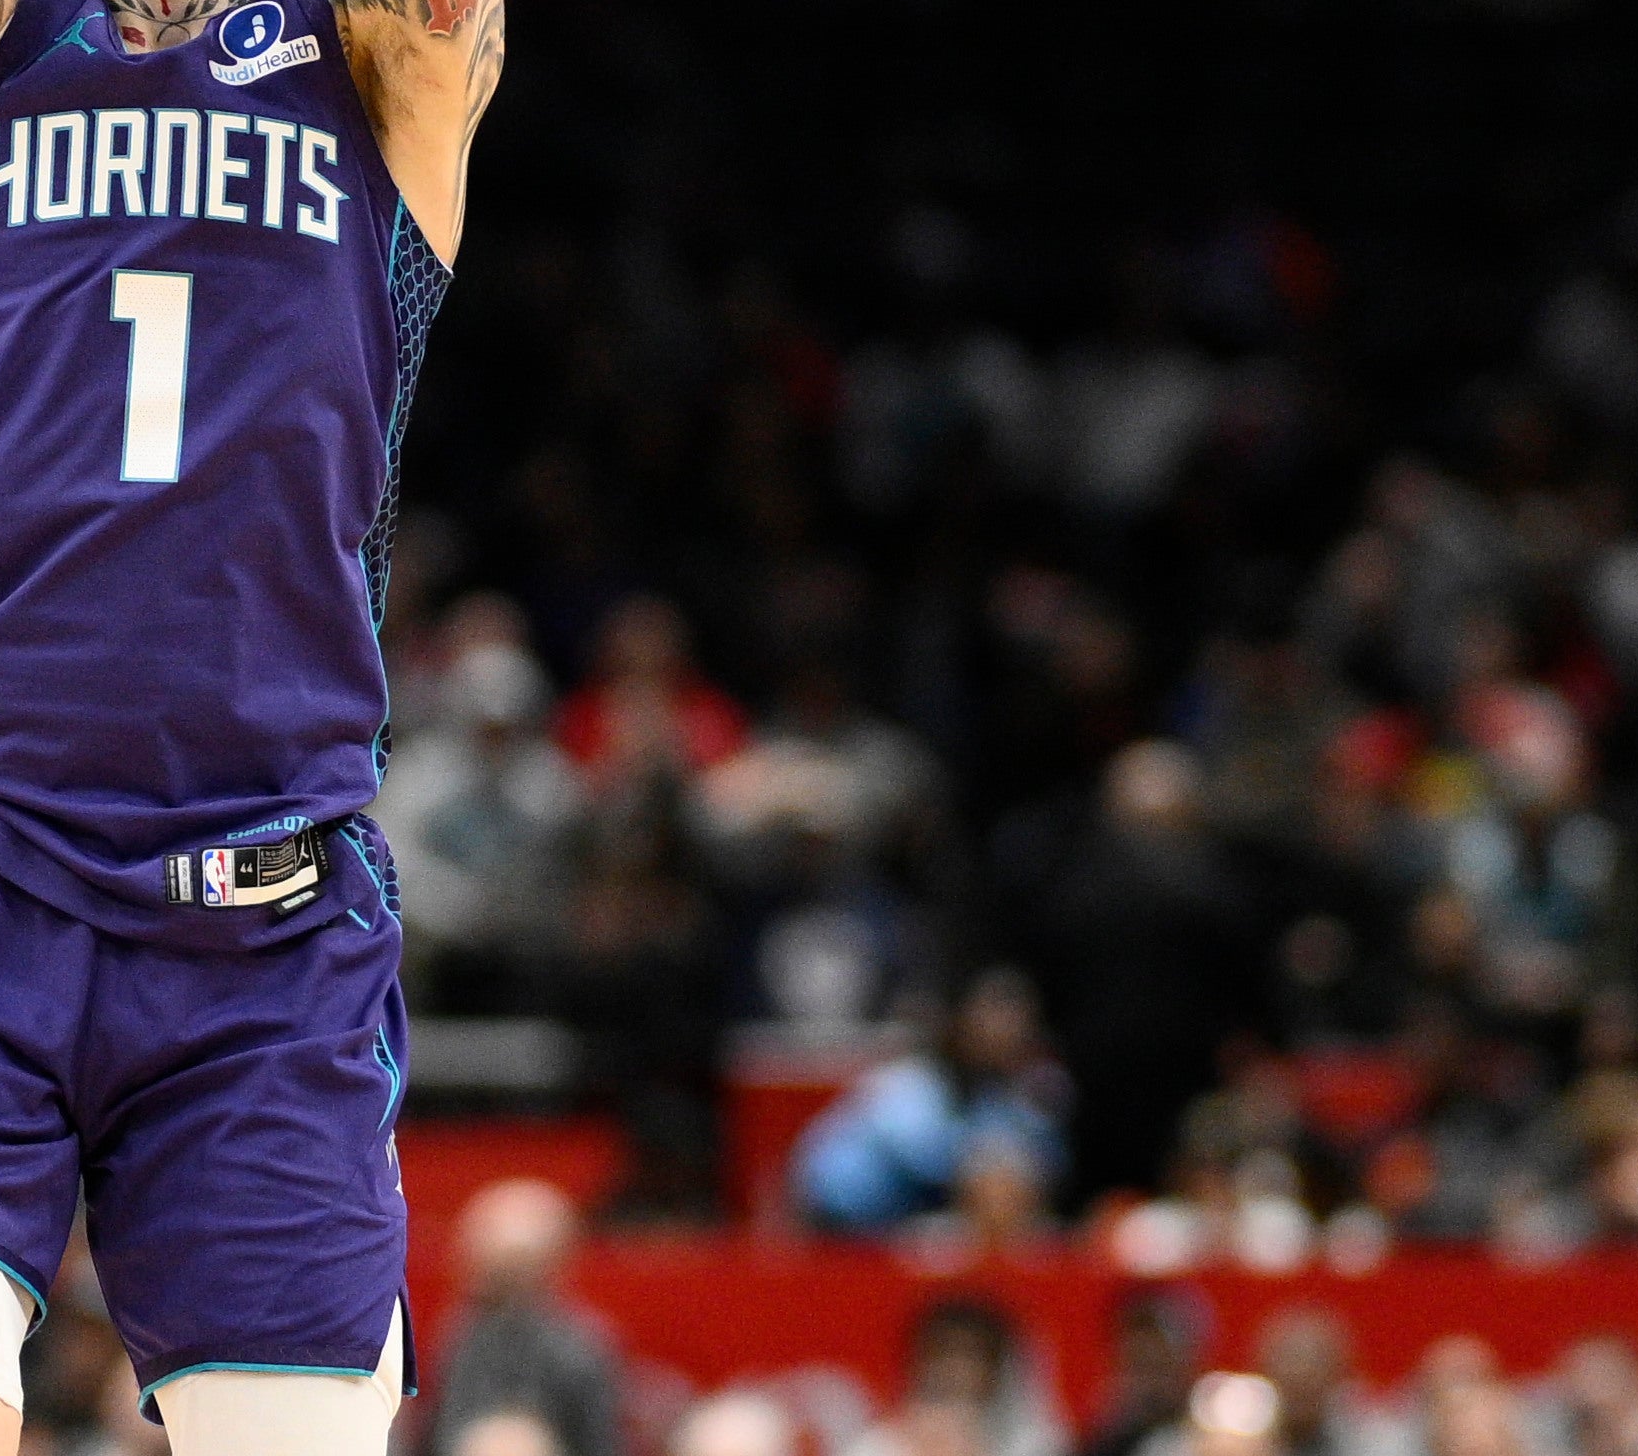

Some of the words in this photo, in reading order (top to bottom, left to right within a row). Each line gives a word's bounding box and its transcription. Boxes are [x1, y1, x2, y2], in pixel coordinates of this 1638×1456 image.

[213, 64, 257, 82] Judi
[256, 40, 318, 74] Health
[109, 268, 193, 482] 1
